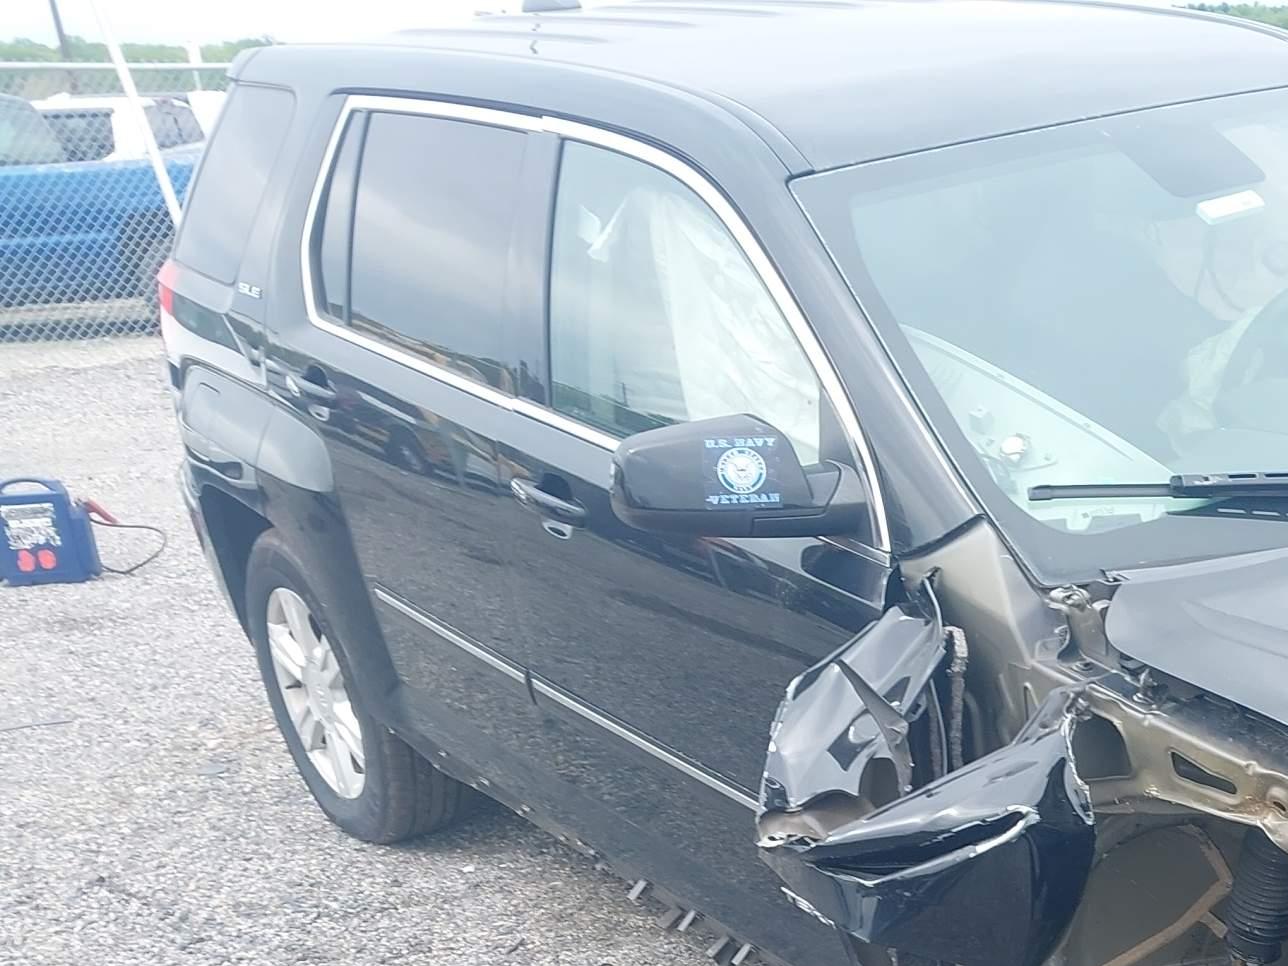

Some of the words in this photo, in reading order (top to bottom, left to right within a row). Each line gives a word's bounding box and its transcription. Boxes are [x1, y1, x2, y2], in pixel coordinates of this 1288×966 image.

[238, 282, 261, 298] SLE
[734, 437, 776, 448] NAVY
[706, 493, 780, 505] VETERAN
